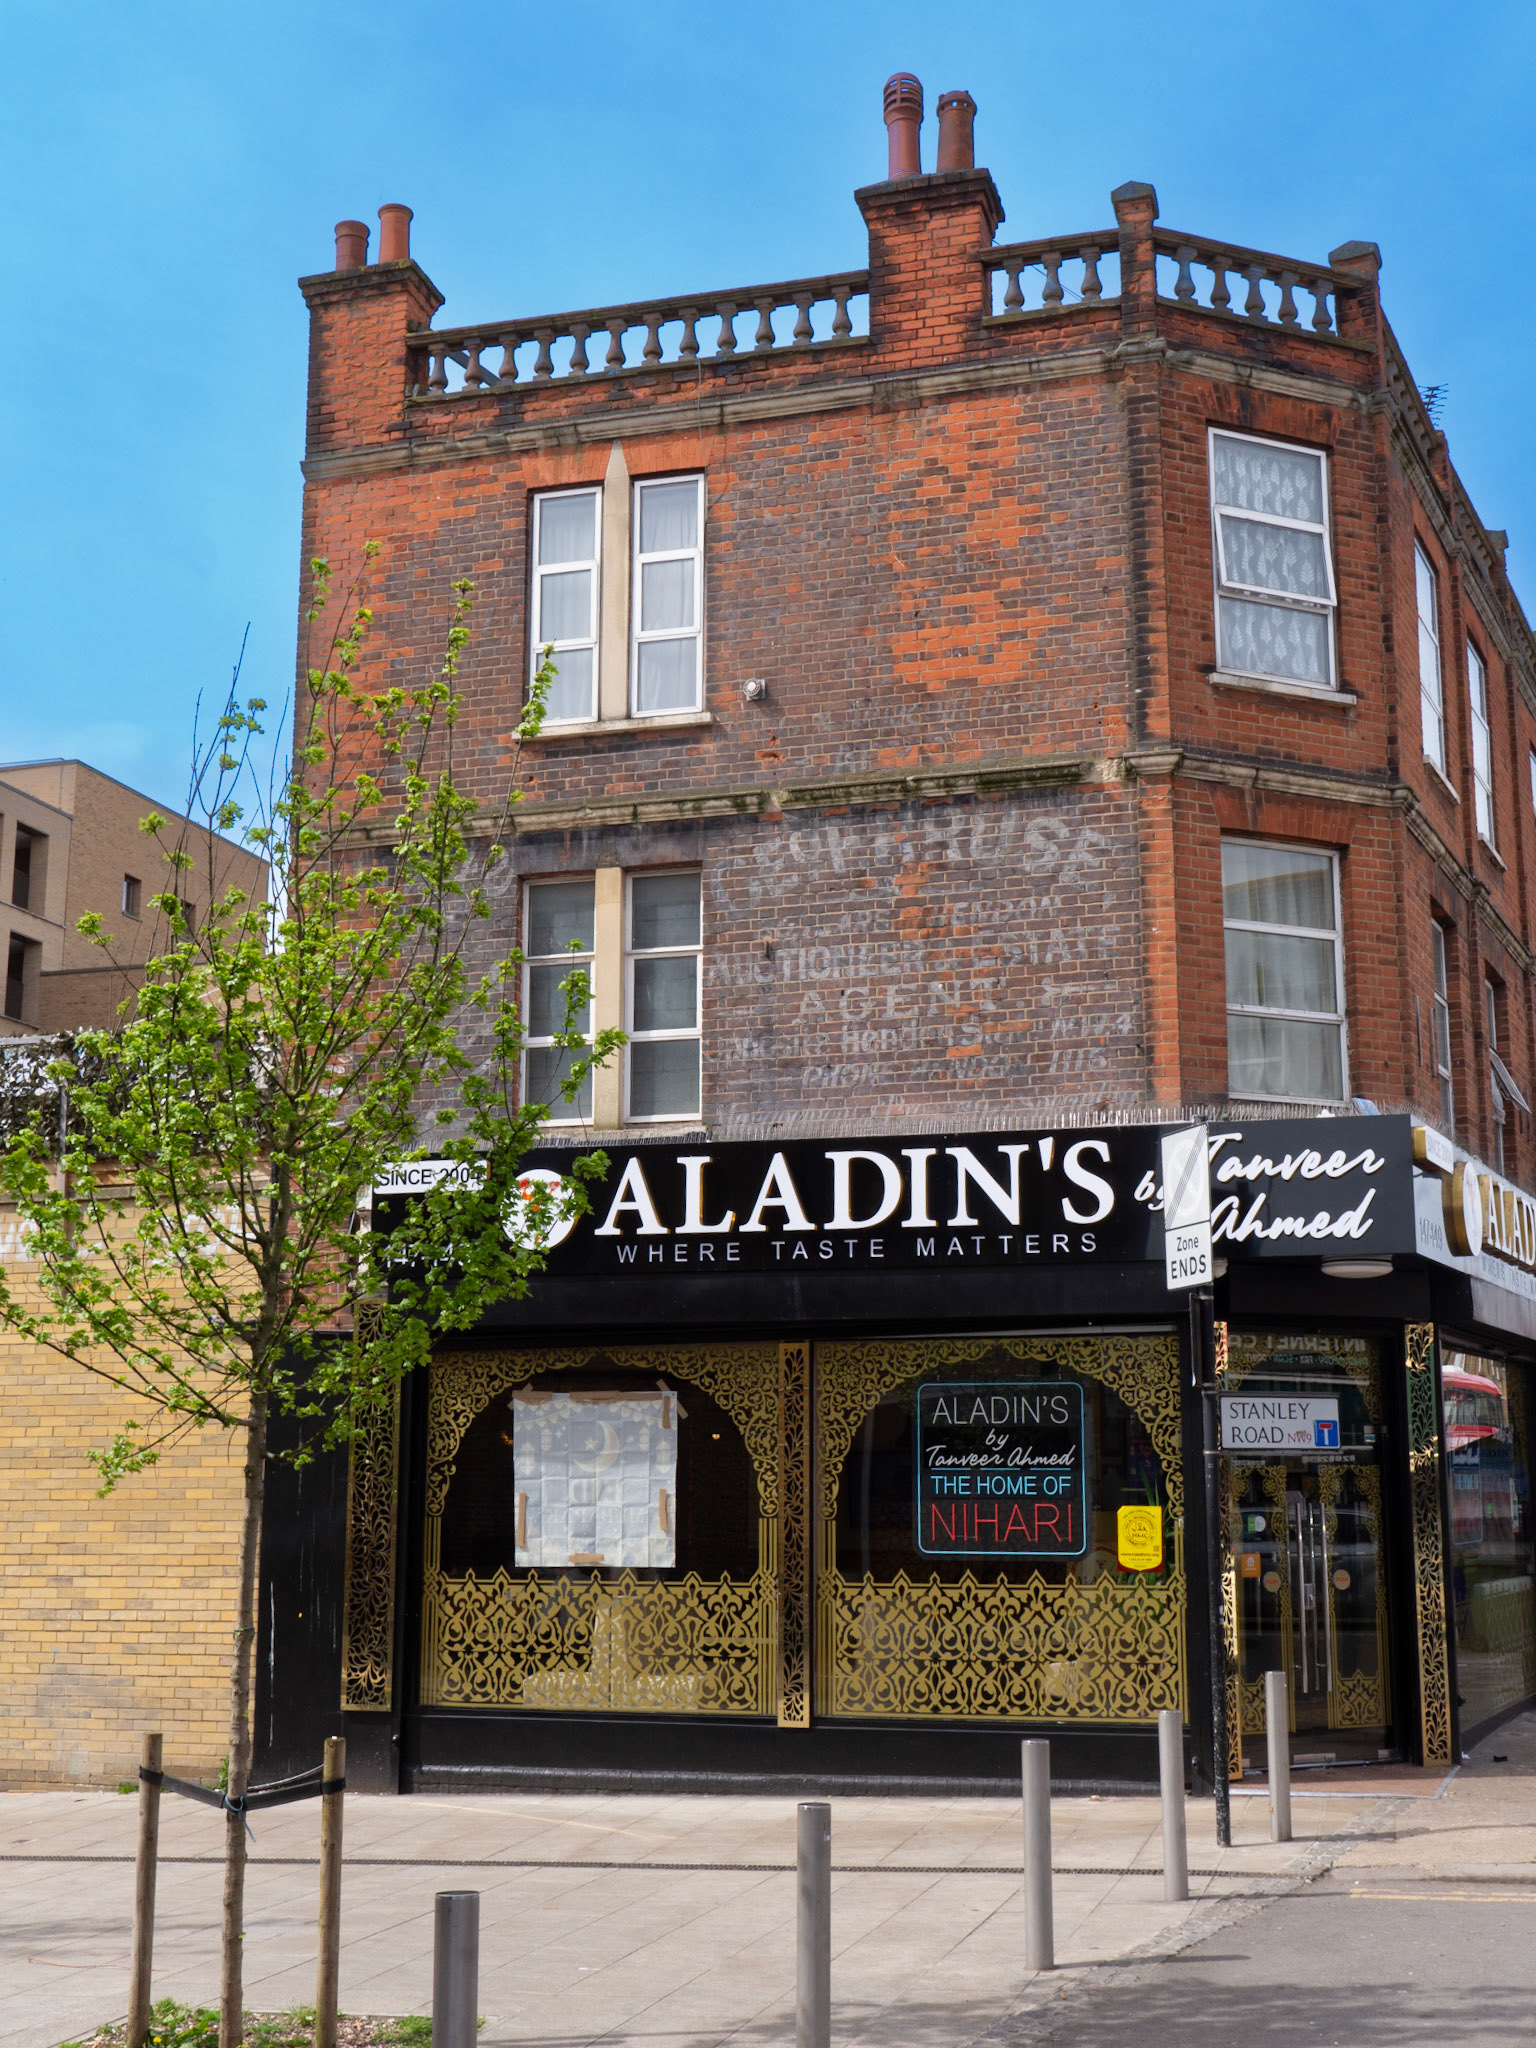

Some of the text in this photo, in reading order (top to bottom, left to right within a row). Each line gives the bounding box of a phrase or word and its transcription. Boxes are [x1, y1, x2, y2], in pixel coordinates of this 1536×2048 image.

[1208, 1132, 1386, 1182] Tanveer
[378, 1169, 433, 1187] SINCE
[594, 1136, 1116, 1237] ALADIN'S
[1211, 1187, 1377, 1243] Ahmed
[616, 1233, 1098, 1263] WHERE TASTE MATTERS
[1177, 1236, 1199, 1252] Zone
[1171, 1254, 1207, 1279] ENDS
[1229, 1402, 1311, 1420] STANLEY
[984, 1428, 1010, 1451] by
[1231, 1426, 1313, 1444] ROAD NW9
[926, 1444, 1077, 1468] Tanveer Ahmed
[930, 1475, 1072, 1496] THE HOME OF
[931, 1503, 1072, 1543] NIHARI
